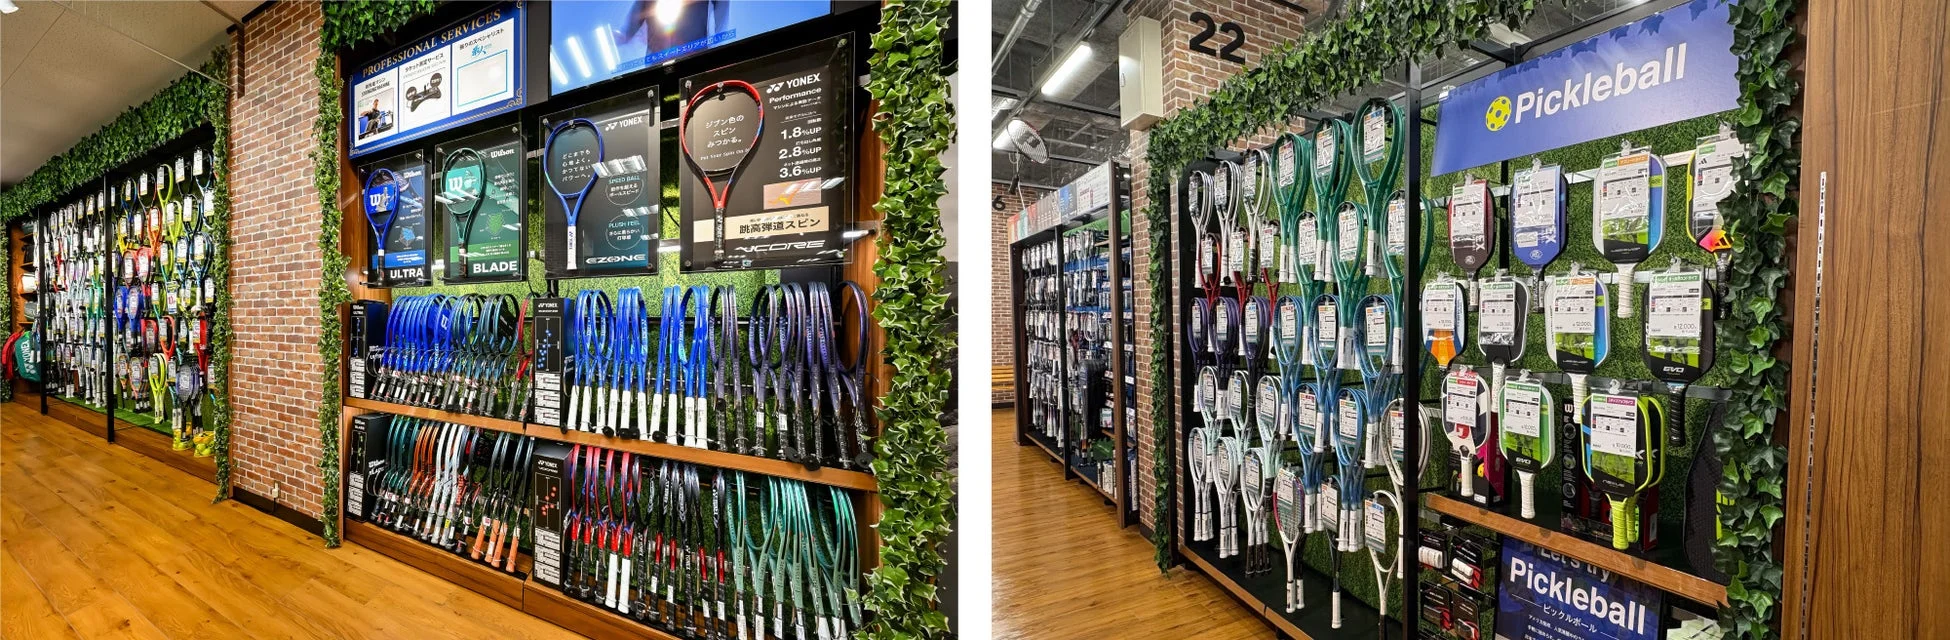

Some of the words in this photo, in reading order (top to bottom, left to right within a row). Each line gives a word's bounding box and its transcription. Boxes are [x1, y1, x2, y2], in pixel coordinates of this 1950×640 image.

[362, 38, 438, 78] PROFESSIONAL
[440, 8, 501, 45] SERVICES
[1189, 11, 1245, 64] 22
[786, 72, 821, 89] YONEX
[1515, 42, 1687, 124] Pickleball
[769, 87, 822, 104] Performance
[619, 116, 643, 128] YONEX
[705, 114, 744, 129] ジブン色の
[713, 127, 736, 137] スピン
[781, 126, 821, 140] 1.8%UP
[707, 137, 742, 148] みつかる。
[491, 149, 515, 159] Wilson
[562, 149, 590, 160] どこまでも
[779, 146, 821, 160] 2.8%UP
[562, 165, 590, 175] かつてない
[779, 165, 821, 178] 3.6%UP
[734, 240, 826, 253] VCORE
[585, 253, 646, 264] EZONE
[390, 268, 424, 279] ULTRA
[472, 260, 518, 274] BLADE
[1540, 548, 1581, 569] Lets
[1510, 556, 1646, 636] Pickleball
[1543, 603, 1597, 633] ピックルボール
